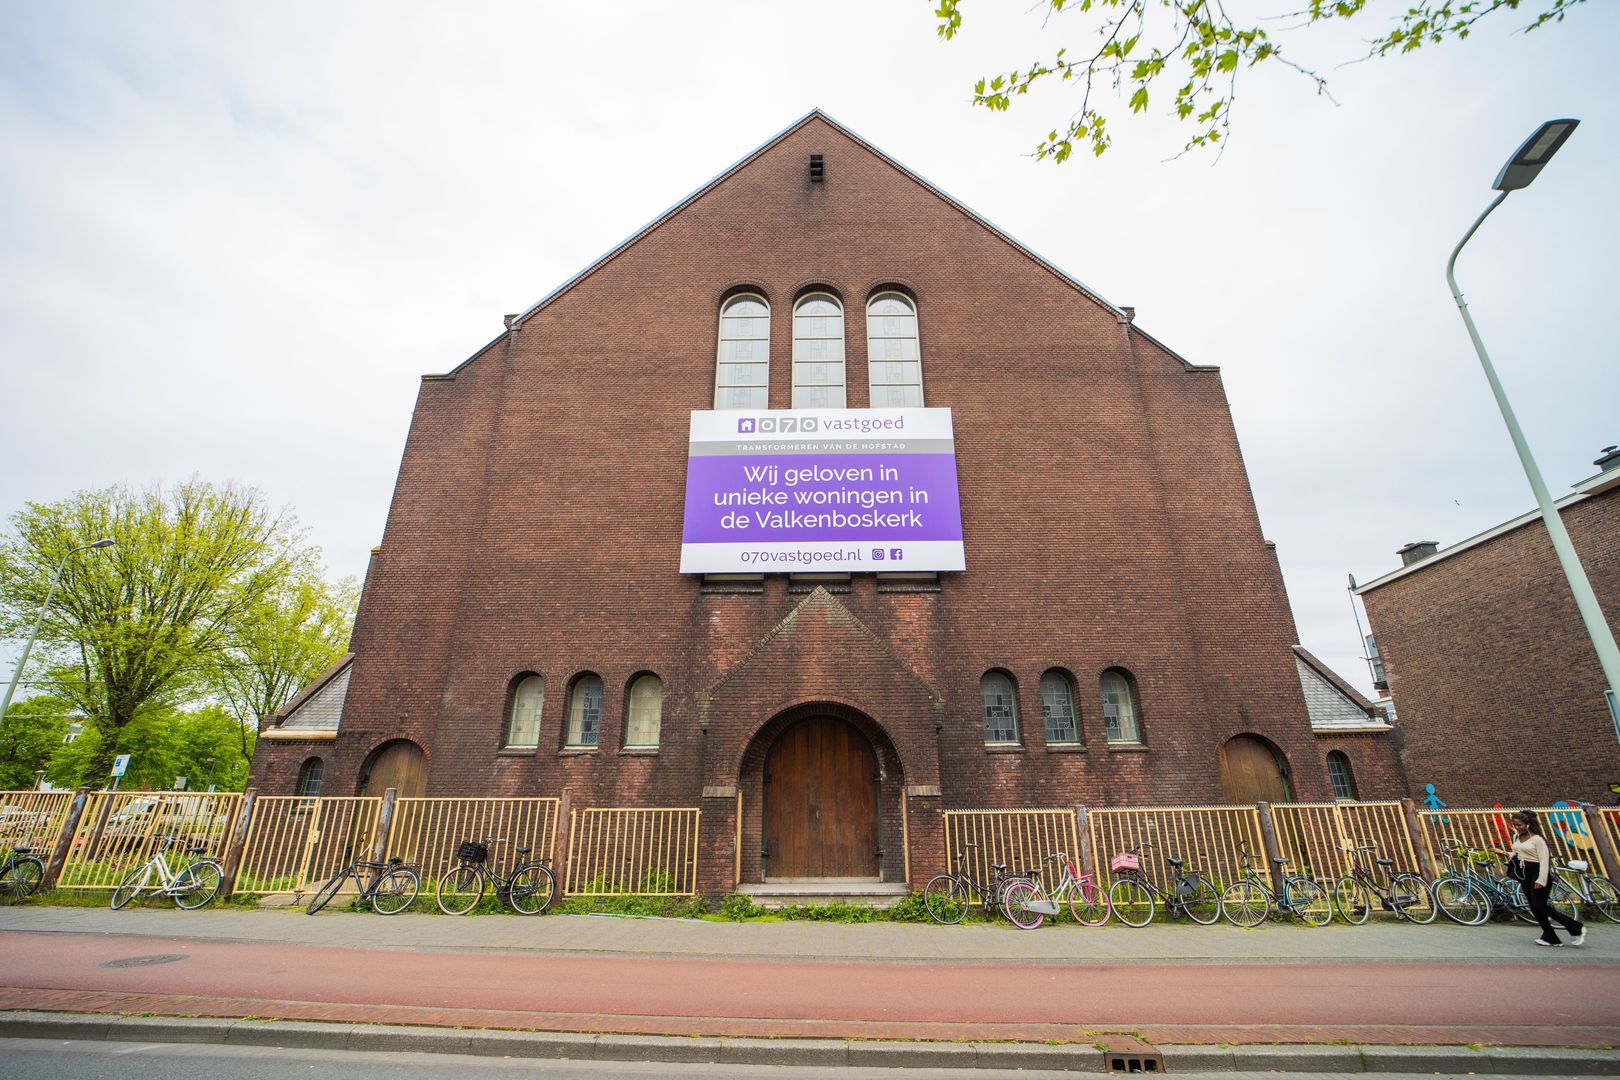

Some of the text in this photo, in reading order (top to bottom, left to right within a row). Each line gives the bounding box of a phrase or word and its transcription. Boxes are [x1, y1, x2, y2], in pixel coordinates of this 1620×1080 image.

[761, 416, 904, 433] 070 vastgoed
[736, 443, 819, 451] TRANSFORMEREN
[743, 464, 898, 486] Wij geloven in
[714, 486, 928, 508] unieke woningen in
[720, 509, 923, 529] de Valkenboskerk
[741, 548, 862, 565] 070vastgoed.nl
